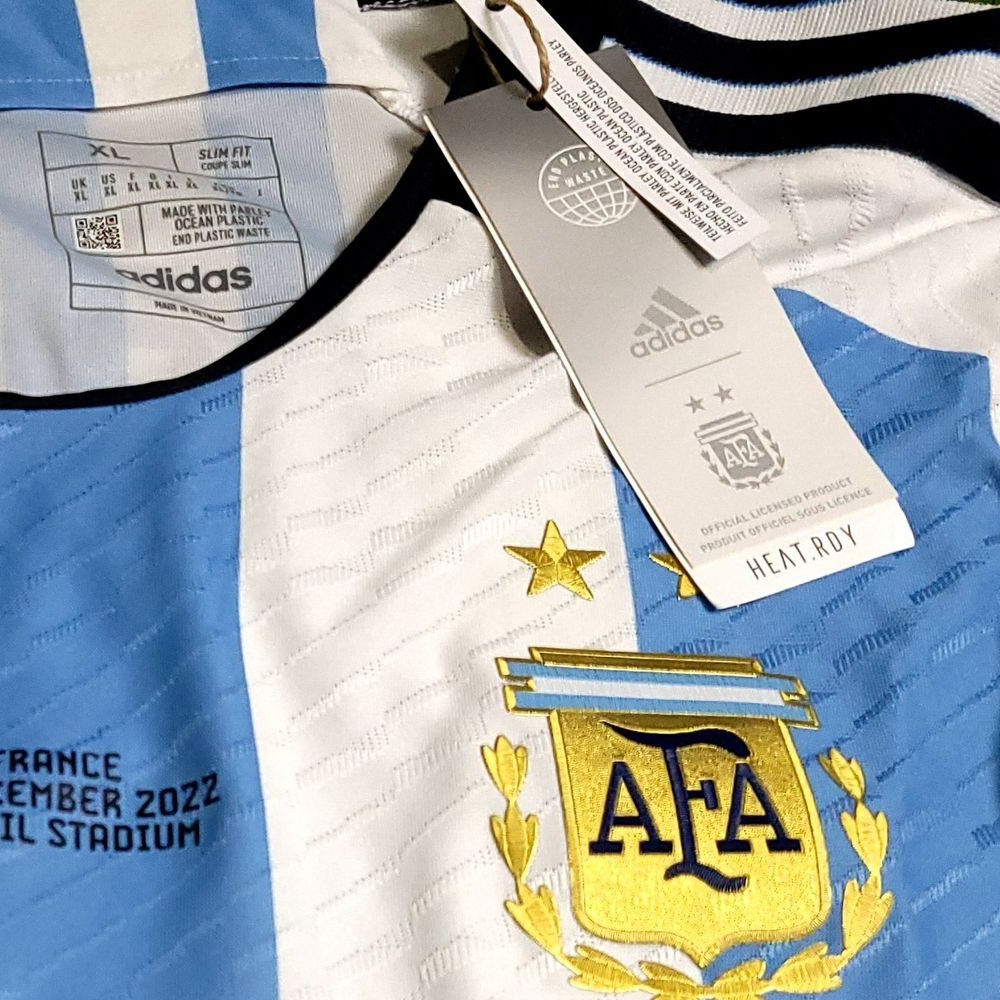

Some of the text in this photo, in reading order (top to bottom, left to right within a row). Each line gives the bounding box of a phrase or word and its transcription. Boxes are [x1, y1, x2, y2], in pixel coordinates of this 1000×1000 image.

[547, 38, 748, 227] FEITO PARCIALMENTE COM PLÁSTICO DOS OCEANOS PARLEY
[88, 143, 131, 160] XL
[199, 145, 252, 160] SLIM FIT
[548, 74, 721, 241] TEILWEISE MIT PARLEY OCEAN PLASTIC HERGESTELL
[560, 150, 602, 167] PLAS
[576, 89, 734, 234] HECHO EN PARTE CON PARLEY OCEAN PLASTIC
[201, 159, 252, 171] COUPE SLIM
[565, 166, 608, 188] WASTE
[71, 178, 88, 191] UK
[101, 173, 117, 185] US
[74, 191, 88, 203] XL
[104, 185, 117, 198] XL
[127, 181, 141, 193] XL
[148, 181, 161, 190] XL
[165, 180, 179, 190] XL
[161, 203, 271, 219] MADE WITH PARLEY
[174, 213, 264, 231] OCEAN PLASTIC
[172, 227, 271, 247] END PLASTIC WASTE
[115, 265, 253, 294] adidas
[154, 300, 177, 311] MADE
[179, 304, 190, 313] IN
[629, 312, 724, 359] adidas
[699, 487, 873, 553] PRODUIT OFFICIEL SOUS LICENCE
[700, 477, 854, 537] OFFICIAL LICENSED PRODUCT
[746, 524, 858, 581] HEAT.RDY
[135, 771, 223, 819] 2022
[588, 720, 804, 893] AFA
[48, 818, 202, 852] STADIUM
